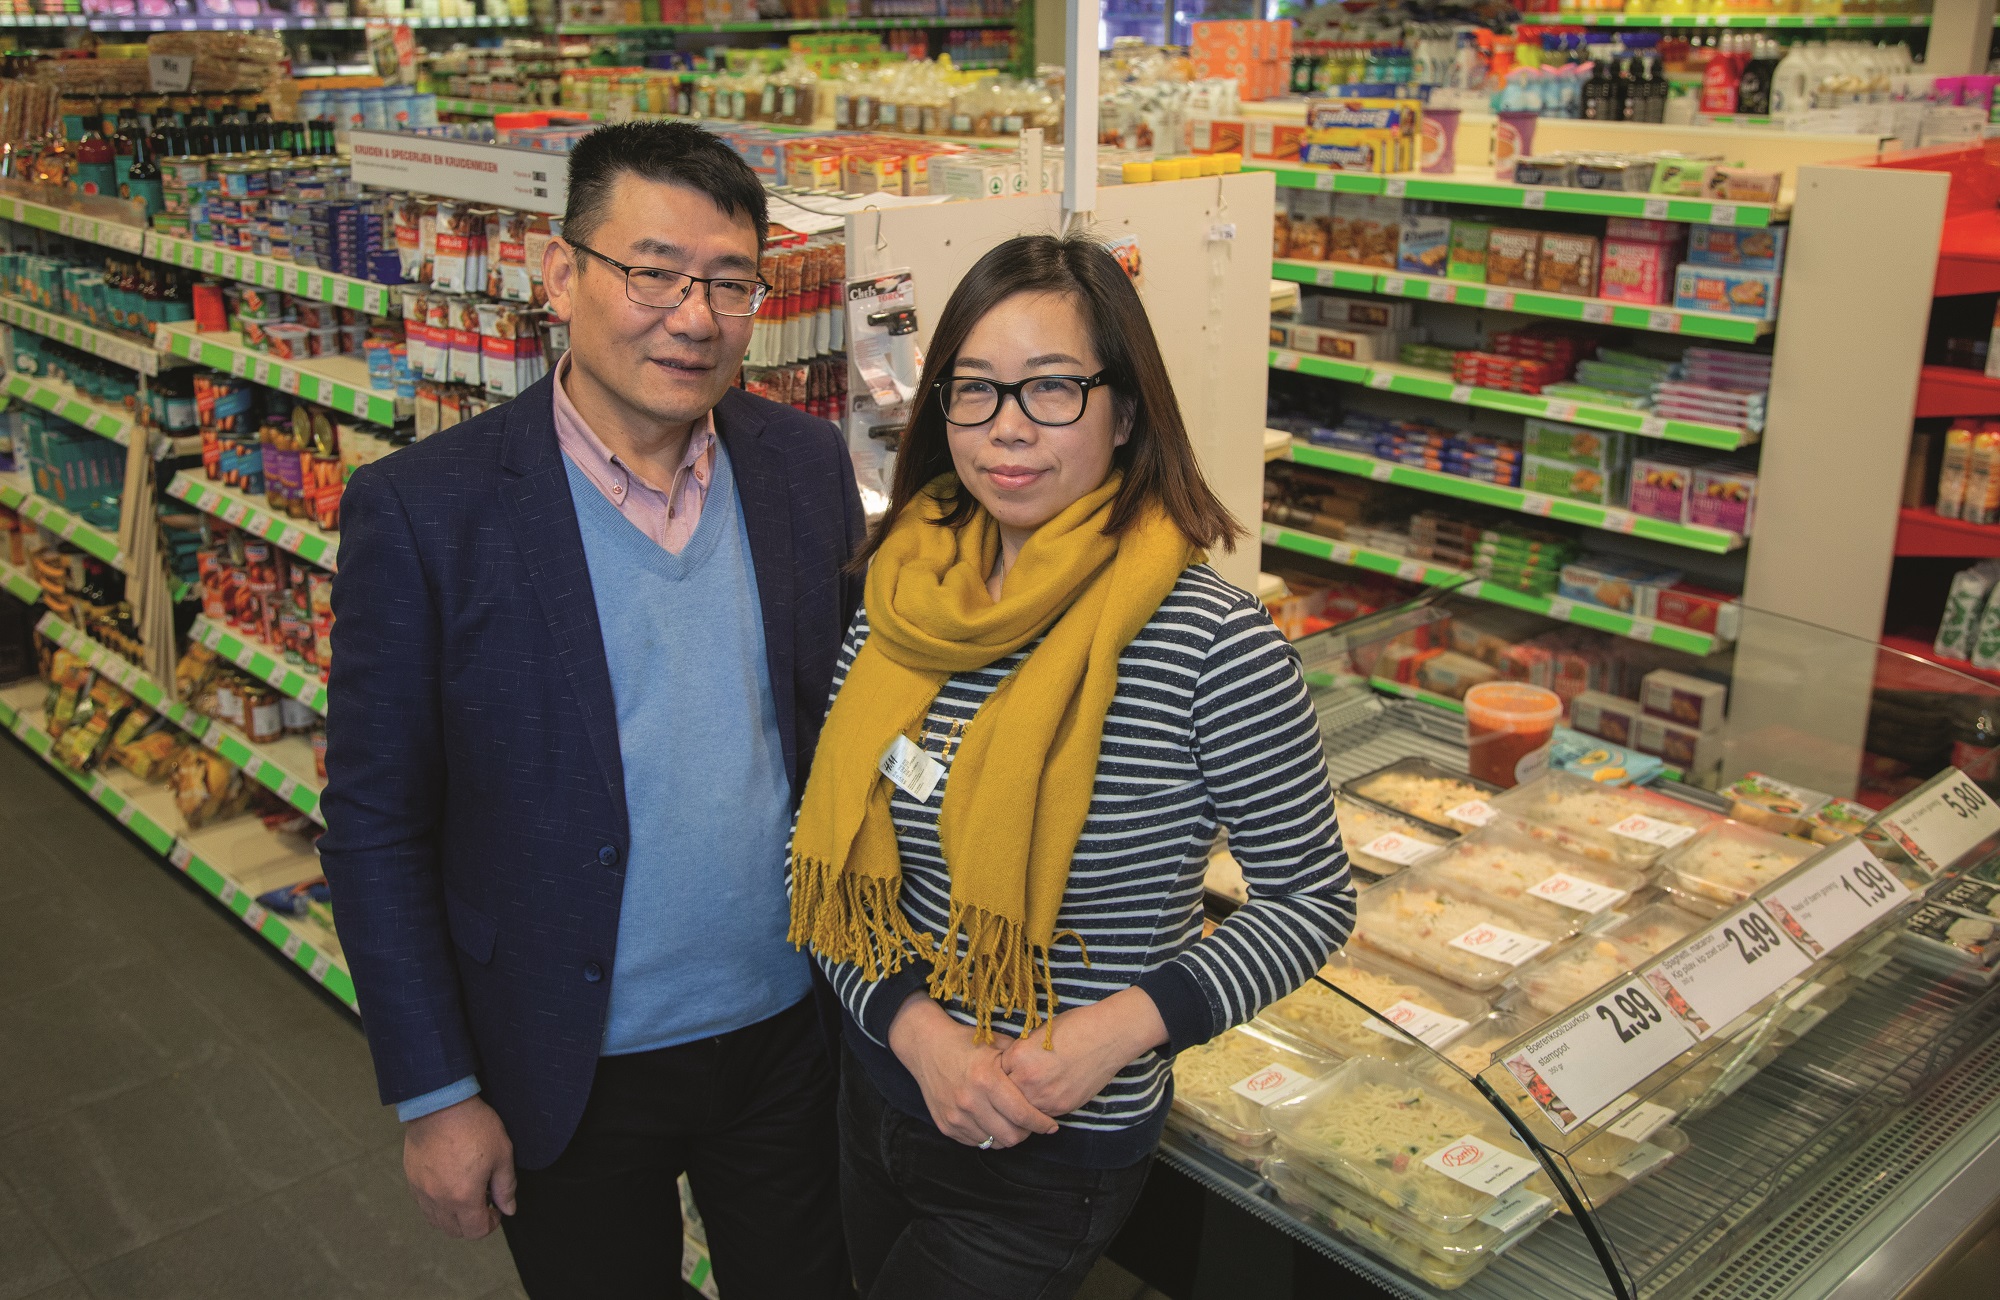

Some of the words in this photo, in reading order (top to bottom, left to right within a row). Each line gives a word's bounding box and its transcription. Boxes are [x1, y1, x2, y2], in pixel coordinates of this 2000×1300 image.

[354, 144, 384, 158] KRUIDEN
[391, 149, 433, 165] SPECERIJEN
[433, 154, 444, 165] EN
[849, 284, 877, 301] Chefs
[1941, 782, 1987, 819] 5,80
[1840, 861, 1896, 908] 1.99
[1661, 950, 1691, 970] Spaghetti,
[1689, 934, 1715, 954] macaroni
[1723, 912, 1781, 964] 2.99
[1670, 968, 1684, 981] Kip
[1695, 952, 1707, 967] kip
[1525, 1010, 1591, 1055] Boerenkool/zuurkool
[1595, 987, 1662, 1044] 2.99
[1537, 1042, 1571, 1068] stamppot
